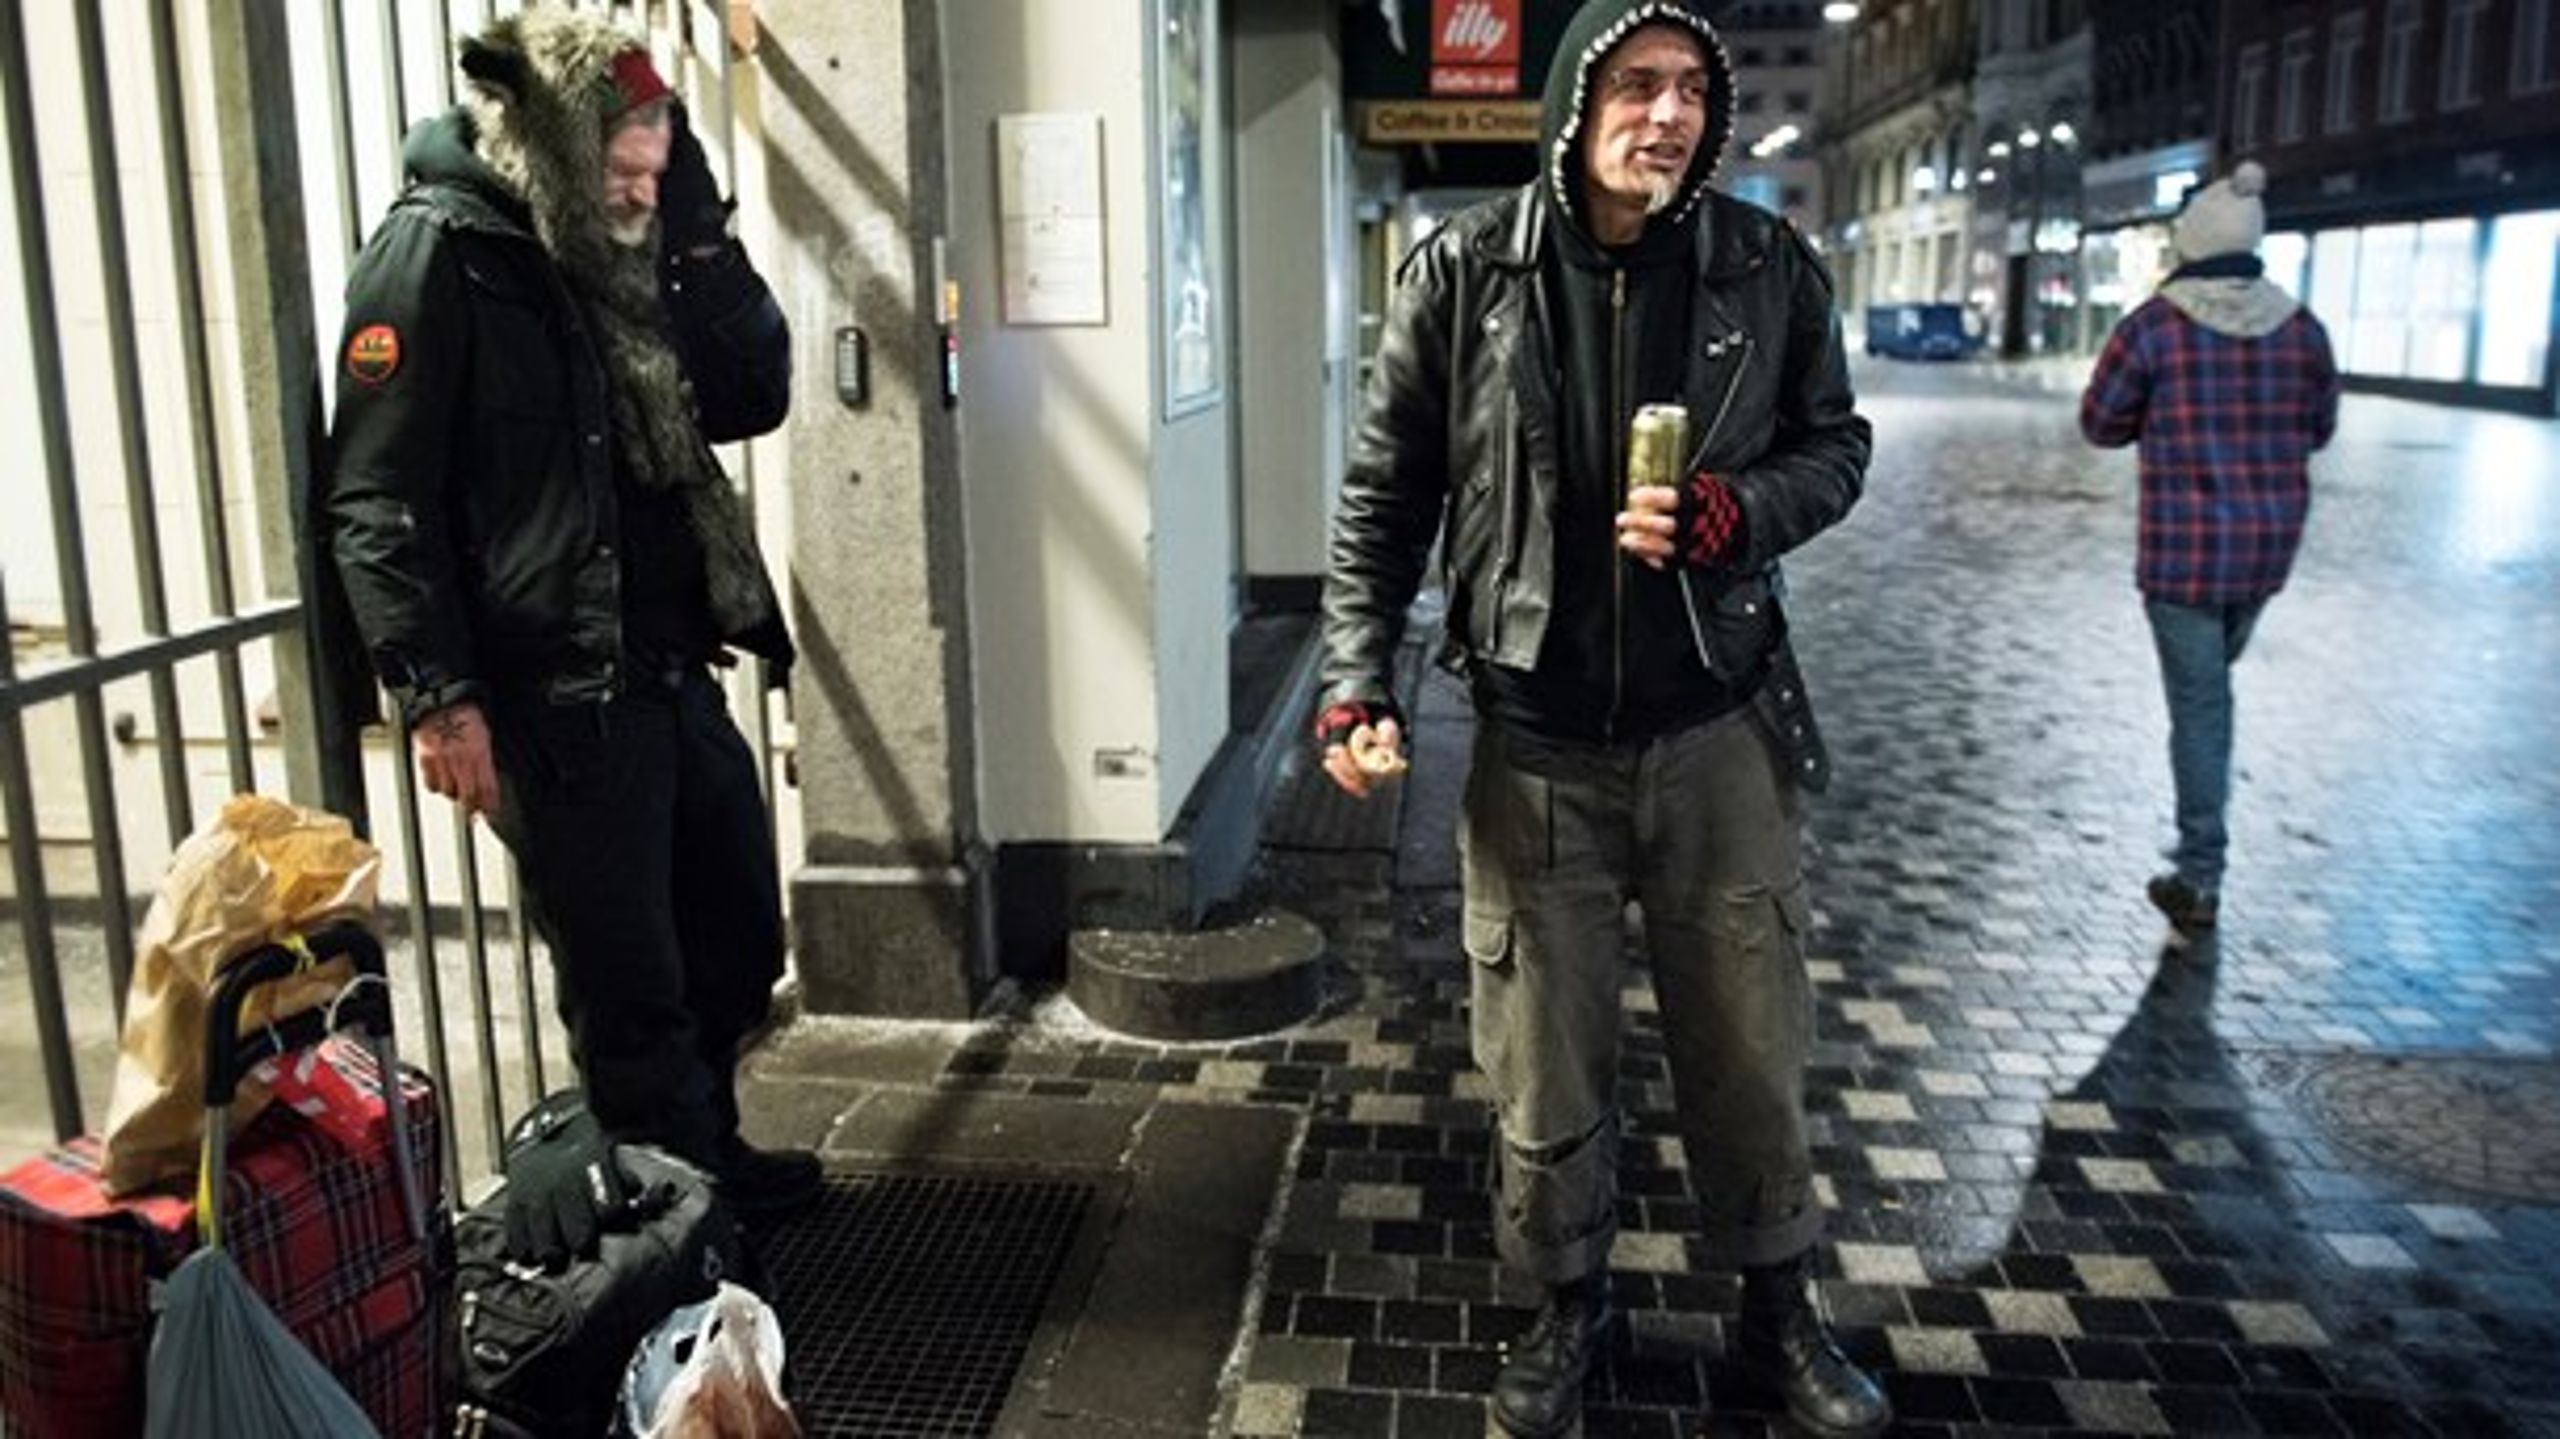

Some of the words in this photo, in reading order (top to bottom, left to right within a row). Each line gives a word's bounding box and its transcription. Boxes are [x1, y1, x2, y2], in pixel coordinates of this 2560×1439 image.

[1443, 2, 1508, 61] illy
[1376, 108, 1450, 131] Coffee
[1455, 109, 1470, 131] &
